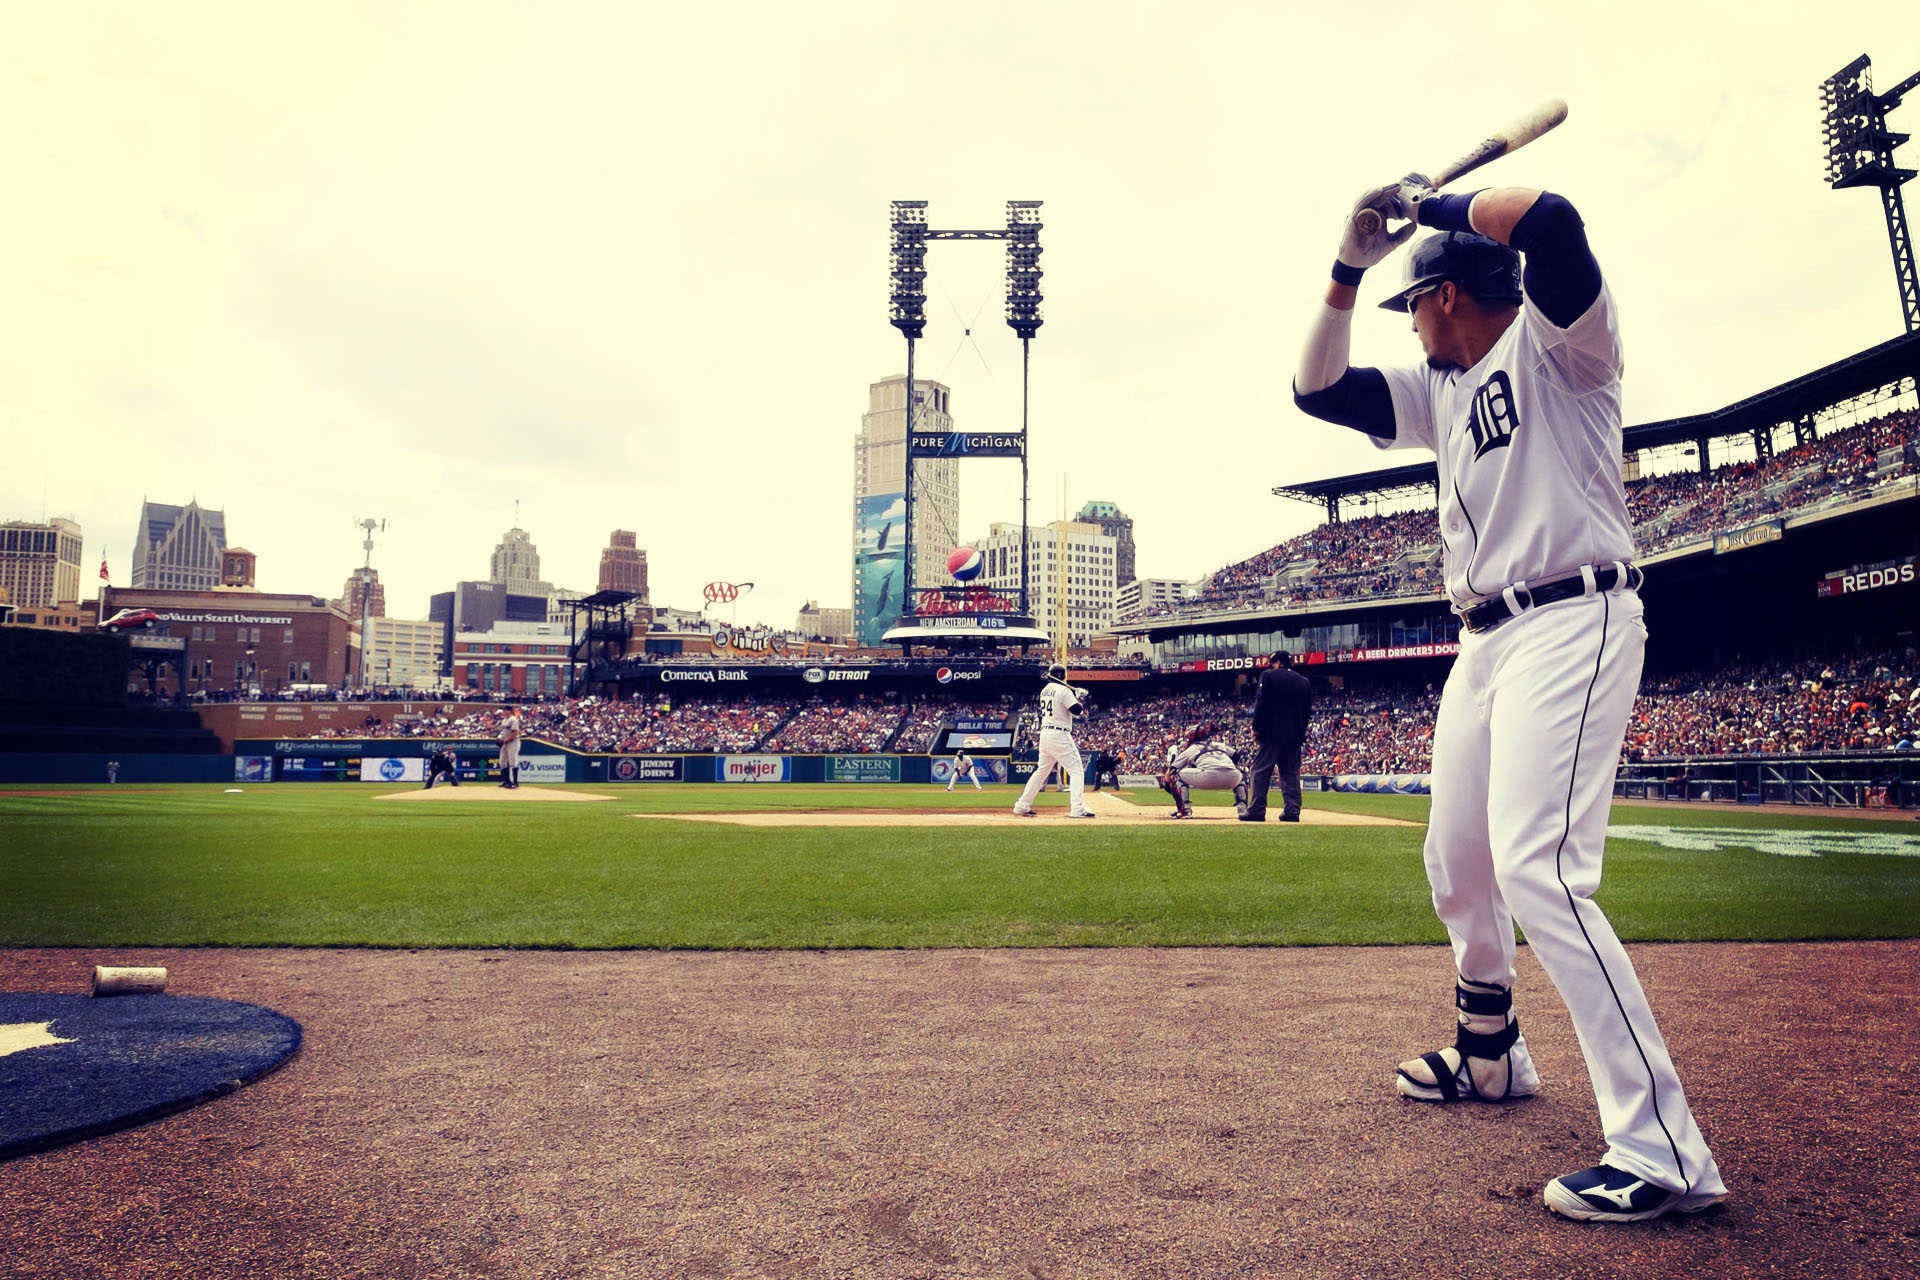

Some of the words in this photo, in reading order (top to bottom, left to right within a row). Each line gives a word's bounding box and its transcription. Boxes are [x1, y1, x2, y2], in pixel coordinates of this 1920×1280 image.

[912, 437, 944, 448] PURE
[937, 431, 1022, 456] MICHIGAN
[1842, 564, 1915, 594] REDDS
[704, 582, 738, 603] AAA
[169, 612, 202, 622] VALLEY
[204, 613, 234, 623] STATE
[234, 614, 292, 624] UNIVERSITY
[919, 617, 934, 629] NEW
[934, 617, 978, 629] AMSTERDAM
[1357, 651, 1364, 660] A
[1365, 650, 1386, 660] BEER
[1388, 645, 1433, 658] DRINKERS
[1207, 657, 1254, 671] REDDS
[717, 669, 749, 681] Bank
[827, 670, 870, 681] DETROIT
[953, 671, 981, 681] pepsi
[1041, 700, 1053, 716] 24
[640, 760, 675, 769] JIMMY
[730, 760, 777, 777] mijer
[834, 757, 892, 770] EASTERN
[640, 769, 675, 779] JOHN'S
